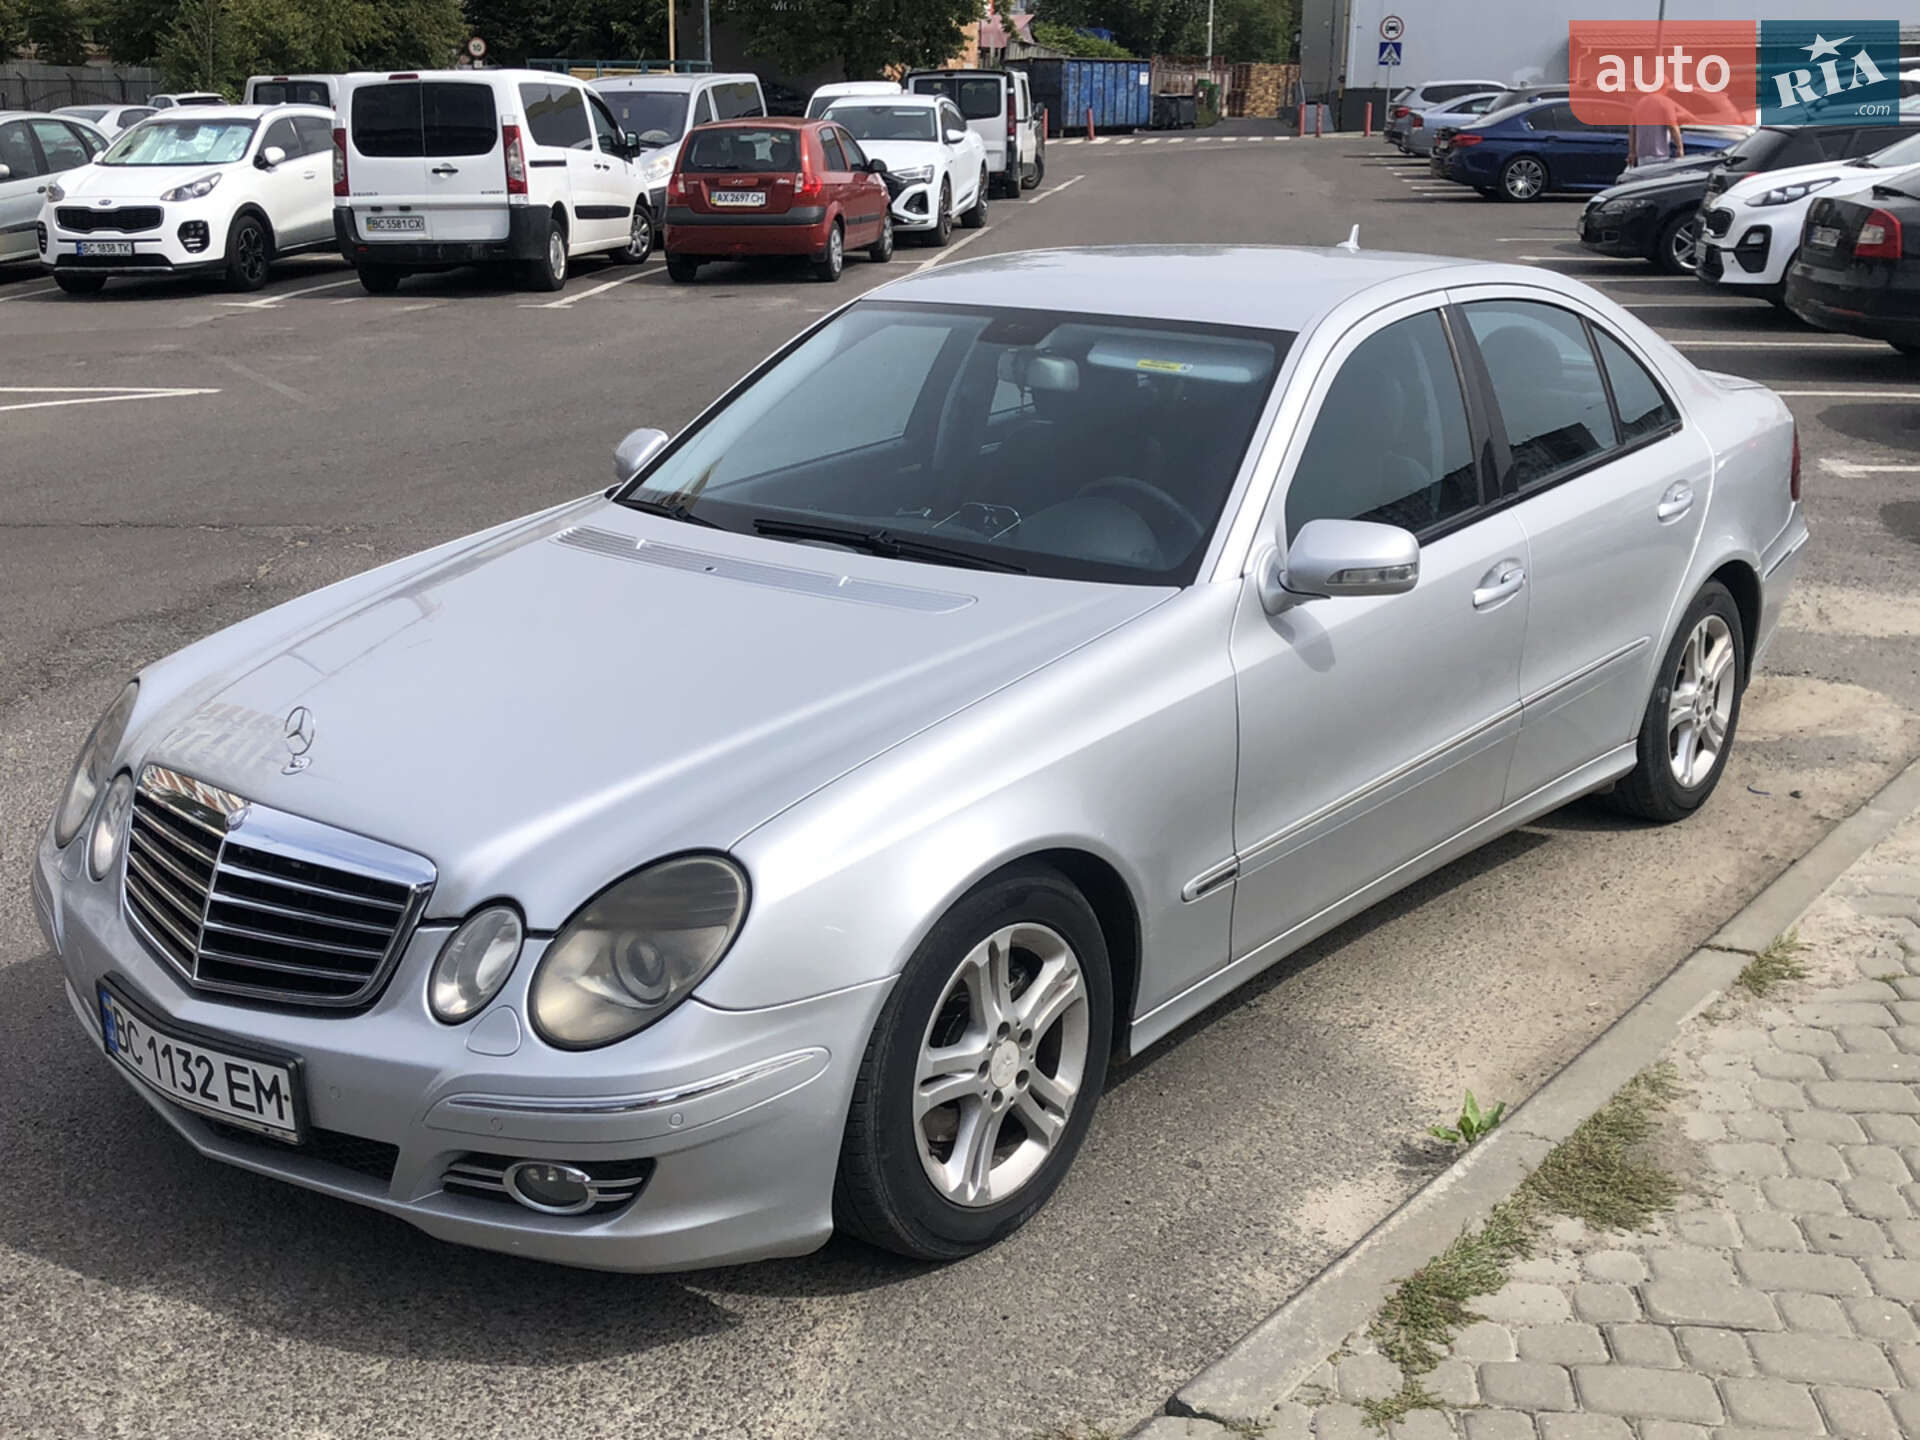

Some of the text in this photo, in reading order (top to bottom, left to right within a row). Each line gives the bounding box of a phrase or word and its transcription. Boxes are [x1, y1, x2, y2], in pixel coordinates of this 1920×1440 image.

[717, 193, 764, 203] AX 2697 CH
[372, 219, 421, 229] BC 5581 CX
[82, 242, 96, 253] BC
[118, 242, 130, 253] TK
[113, 1006, 285, 1121] BC 1132 EM
